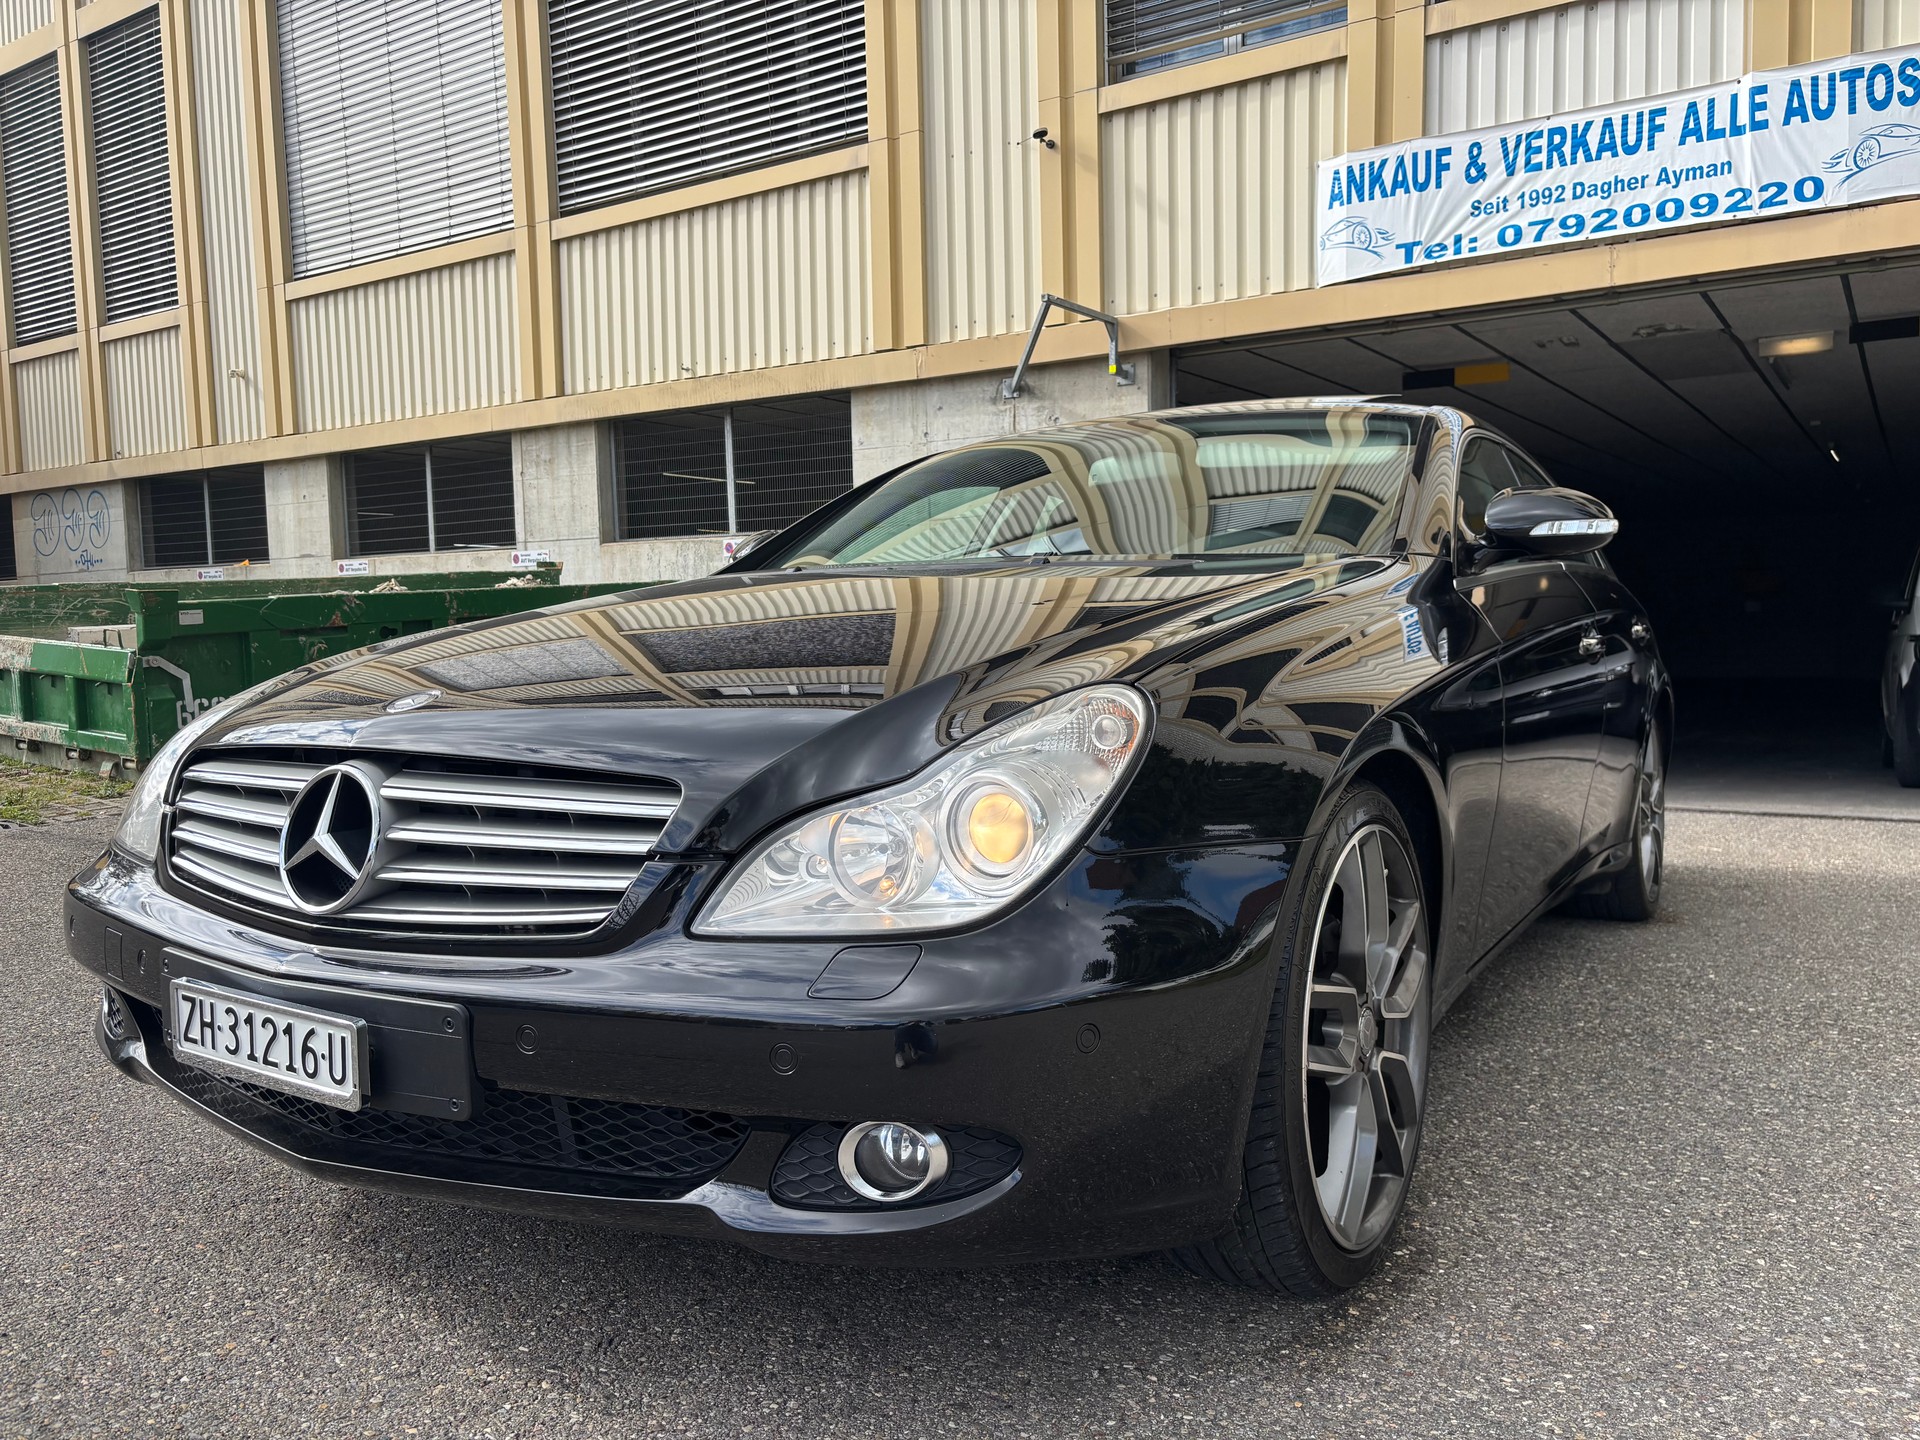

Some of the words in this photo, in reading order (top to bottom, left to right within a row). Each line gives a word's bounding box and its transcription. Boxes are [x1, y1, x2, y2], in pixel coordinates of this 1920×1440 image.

[1328, 147, 1452, 210] ANKAUF
[1464, 141, 1488, 185] &
[1500, 106, 1667, 177] VERKAUF
[1678, 84, 1770, 146] ALLE
[1782, 57, 1920, 127] AUTOS
[1395, 233, 1478, 264] Tel:
[1496, 176, 1825, 247] 0792009220
[1470, 198, 1509, 218] Seit
[1517, 184, 1566, 210] 1992
[1572, 173, 1649, 200] Dagher
[1655, 160, 1732, 188] Ayman
